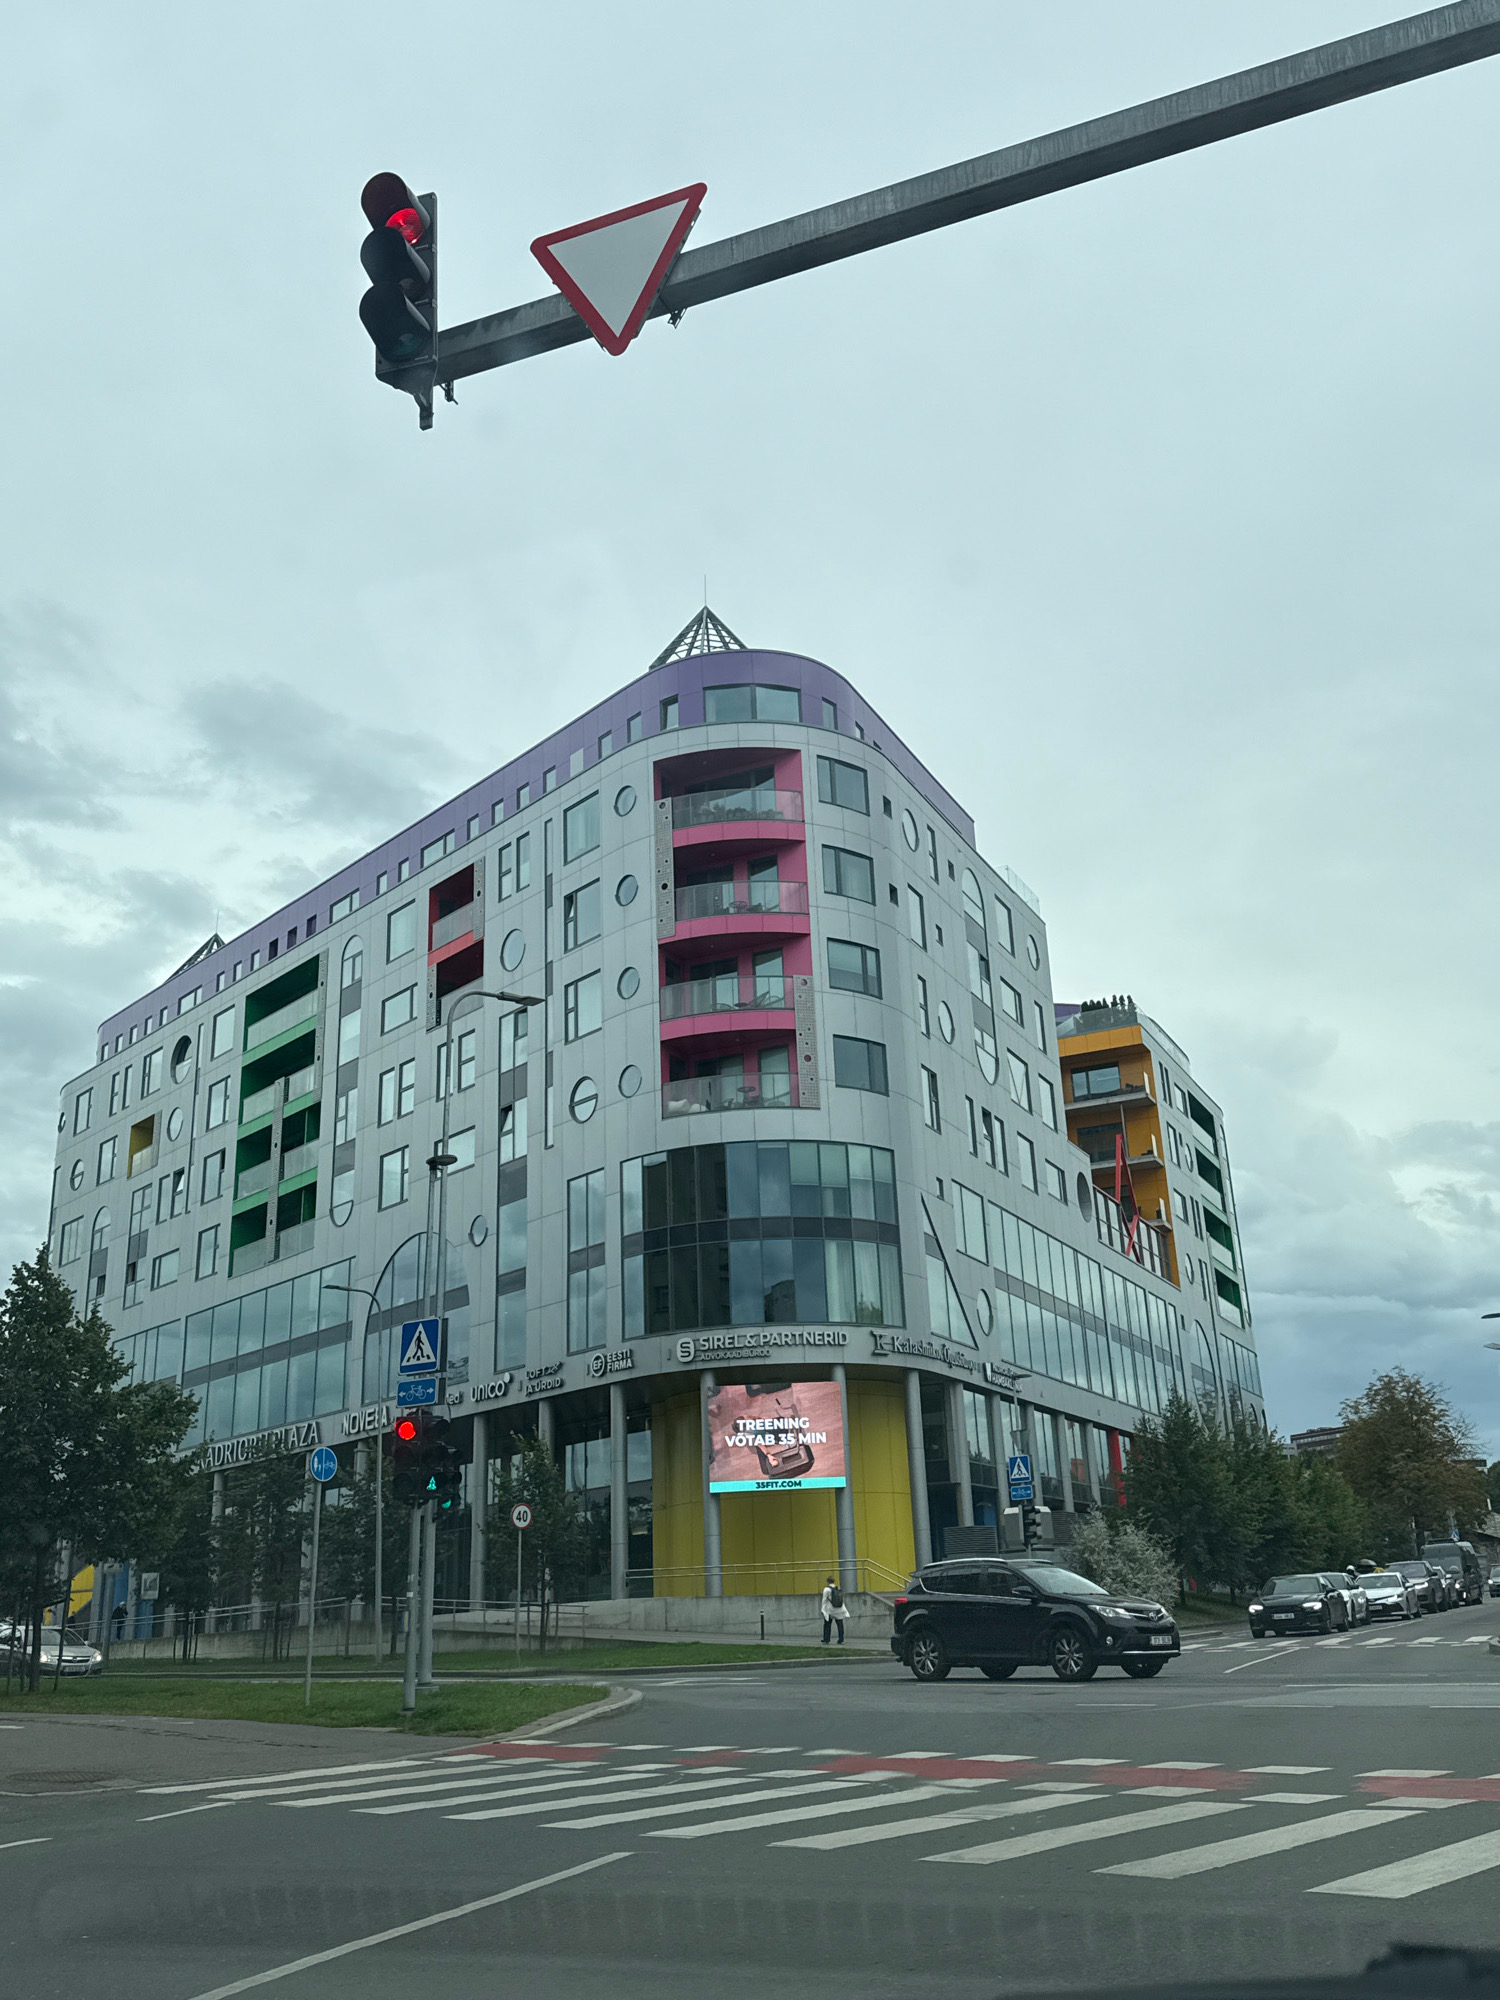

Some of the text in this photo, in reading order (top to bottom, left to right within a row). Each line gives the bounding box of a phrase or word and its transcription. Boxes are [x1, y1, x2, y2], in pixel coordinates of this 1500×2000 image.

[700, 1331, 848, 1350] SIREL & PARTNERID
[607, 1350, 630, 1362] EESTI
[607, 1358, 632, 1373] FIRMA
[737, 1417, 810, 1431] TREENING
[724, 1432, 827, 1447] VÕTAB 35 MIN
[755, 1480, 802, 1489] 35FIT.COM
[515, 1510, 528, 1522] 40
